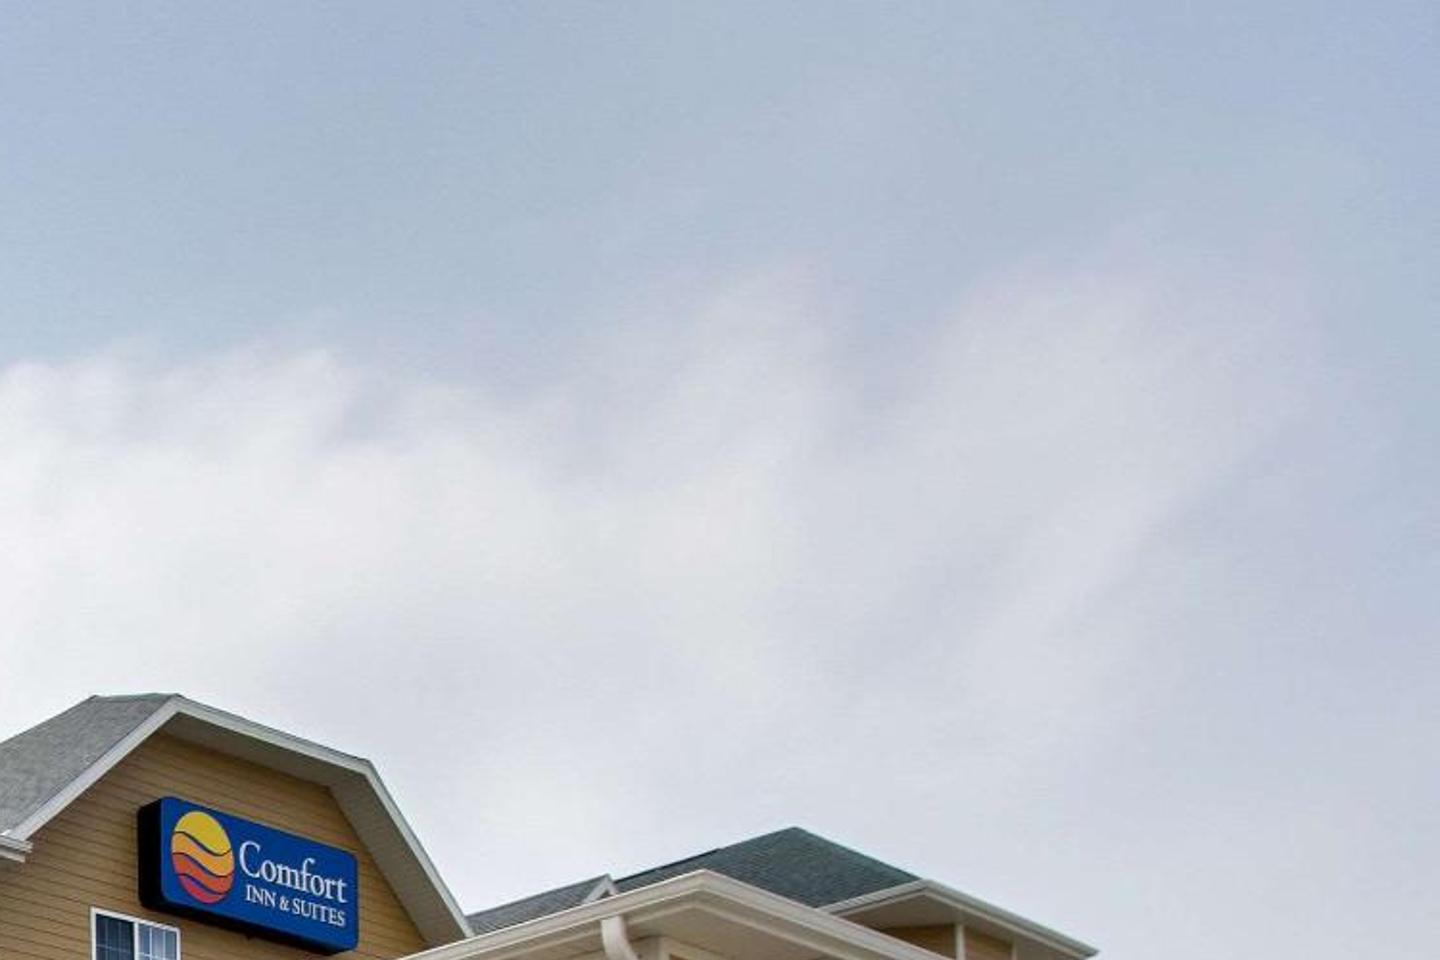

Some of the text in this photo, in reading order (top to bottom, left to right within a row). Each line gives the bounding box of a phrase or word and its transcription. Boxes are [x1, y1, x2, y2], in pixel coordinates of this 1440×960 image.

[239, 841, 347, 902] Comfort
[245, 884, 345, 926] INN & SUITES
